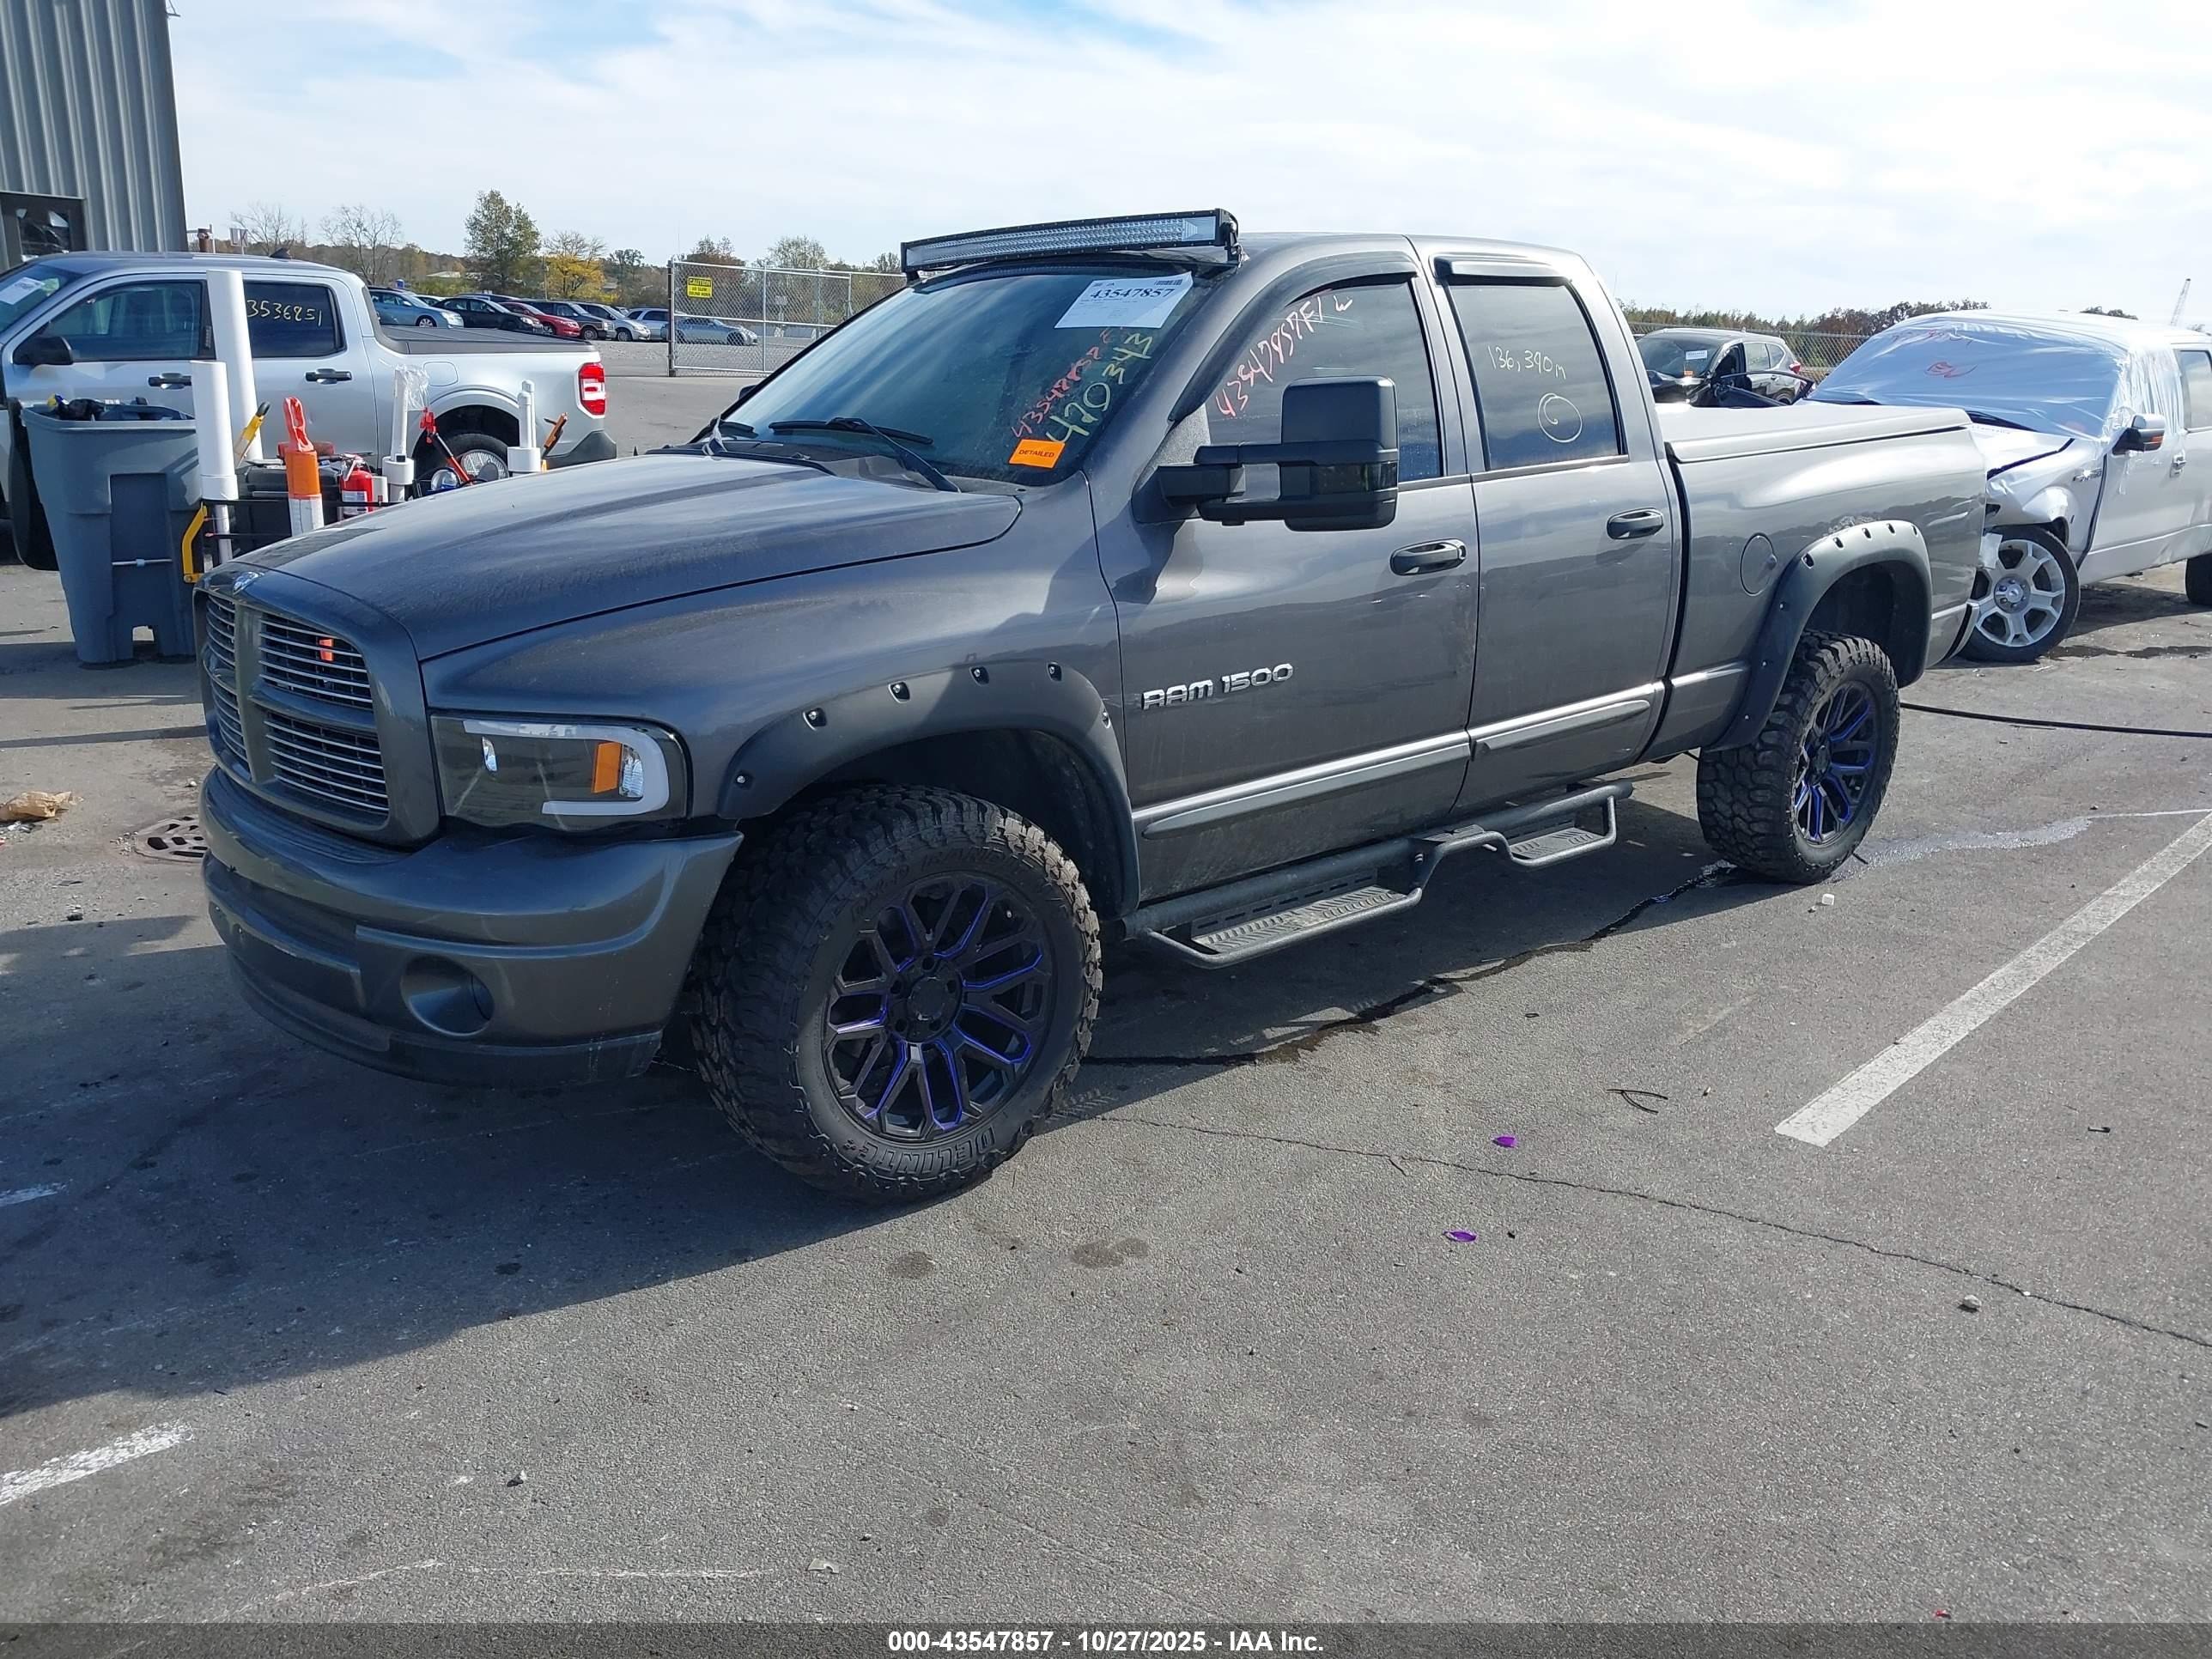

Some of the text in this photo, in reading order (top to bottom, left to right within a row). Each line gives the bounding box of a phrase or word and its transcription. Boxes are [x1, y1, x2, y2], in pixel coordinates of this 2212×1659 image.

[1091, 288, 1176, 299] 43547857
[1018, 449, 1055, 458] DETAILED
[1141, 663, 1293, 710] RAM 1500
[859, 1125, 996, 1175] DELINTE
